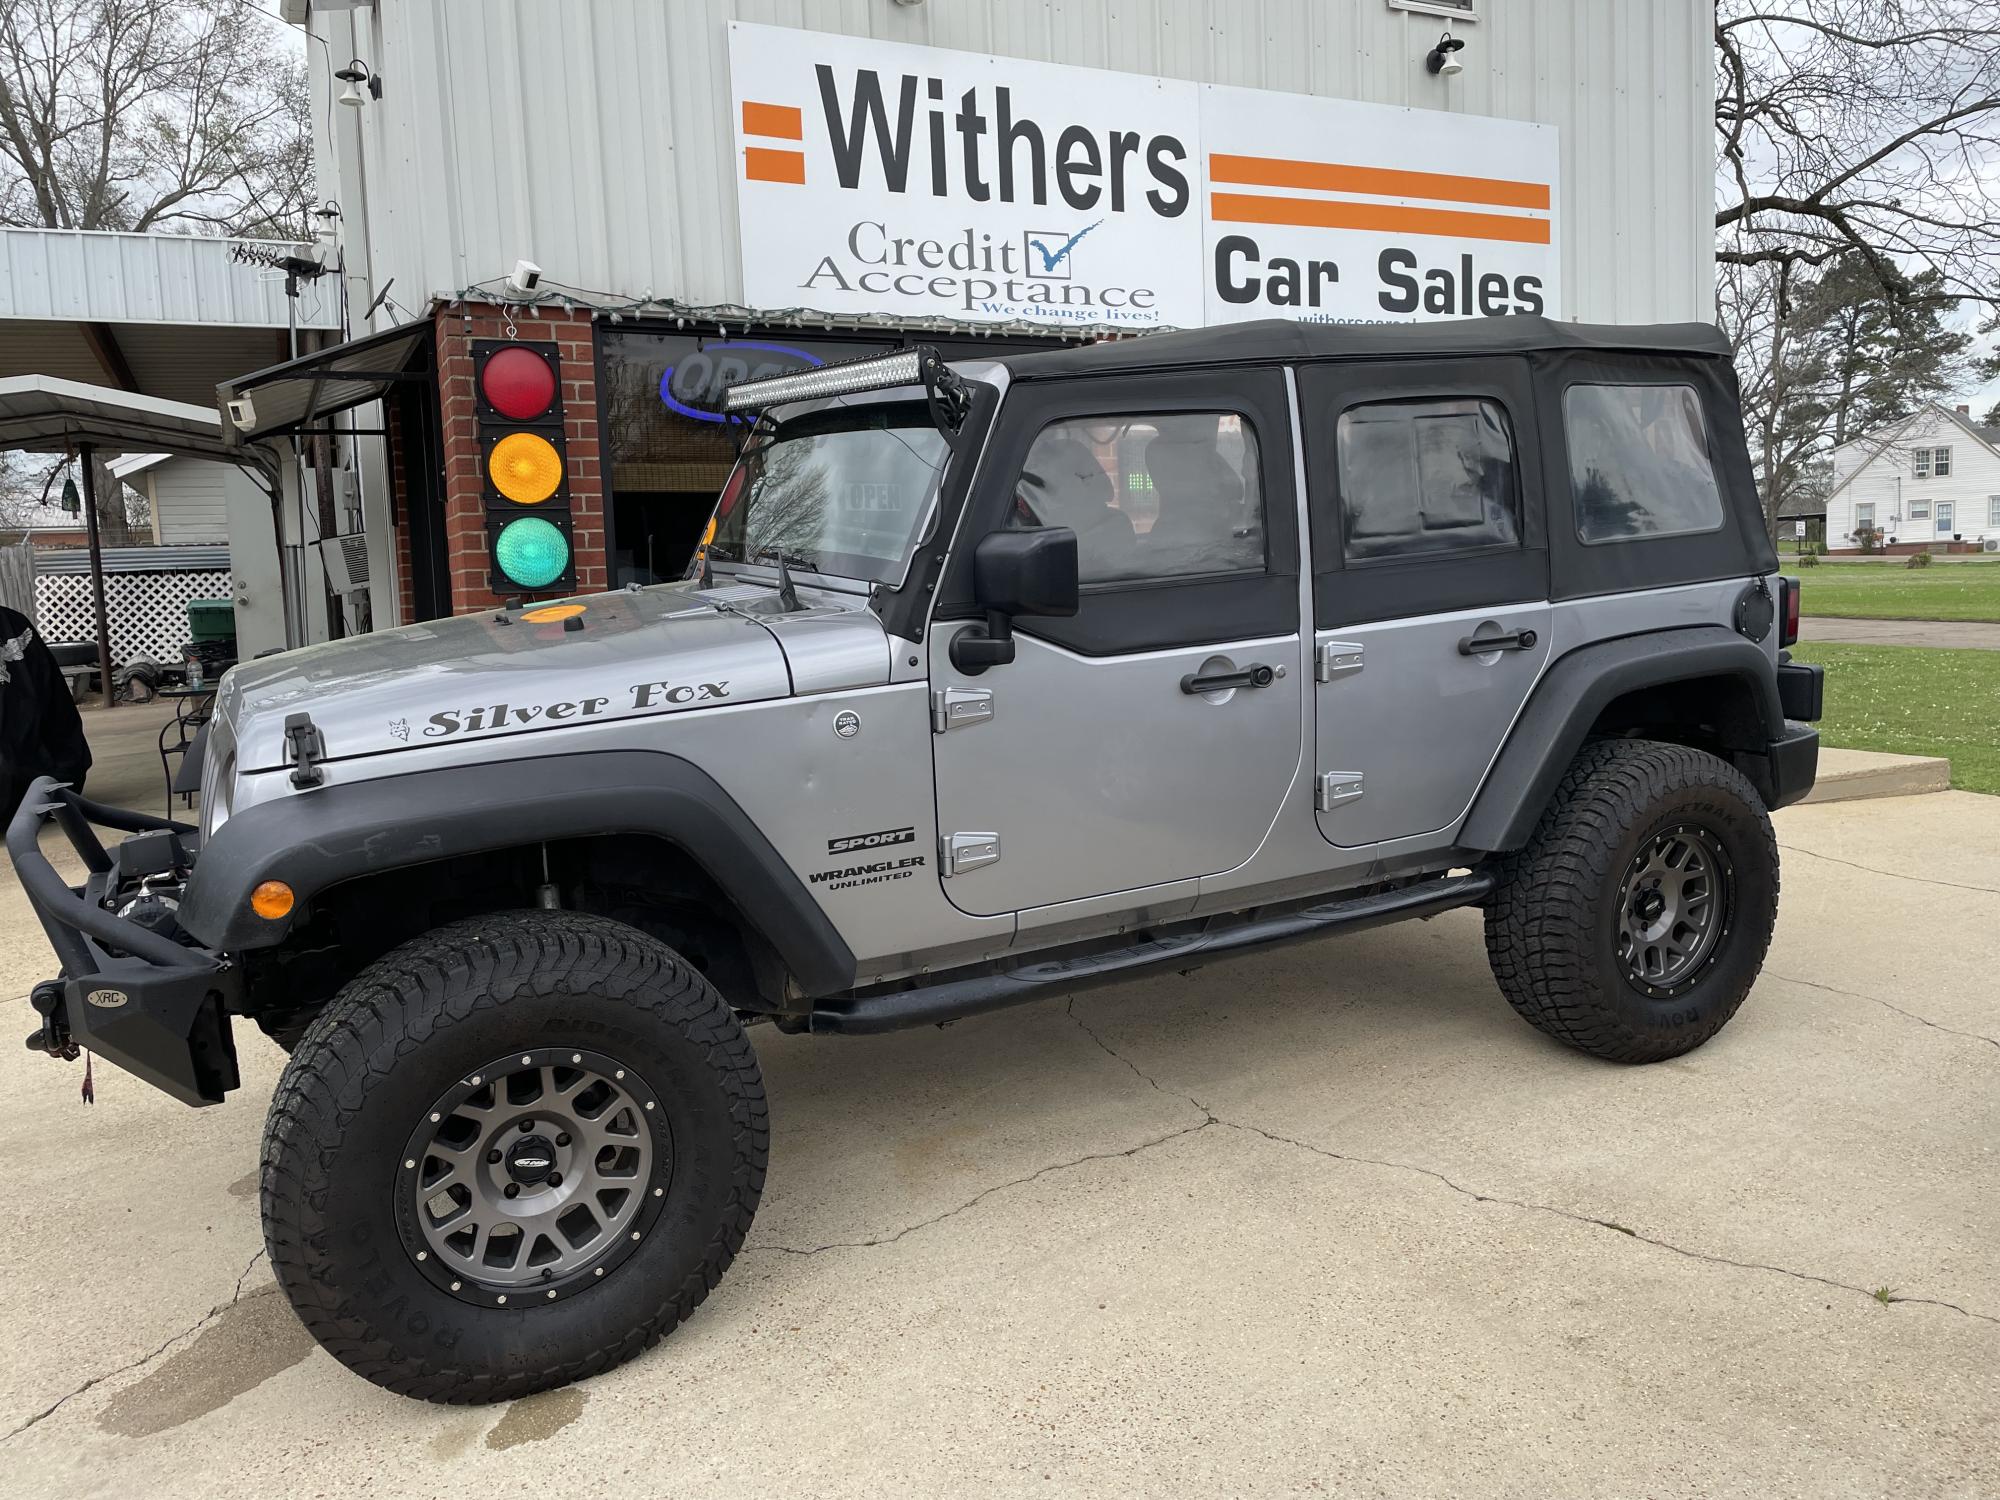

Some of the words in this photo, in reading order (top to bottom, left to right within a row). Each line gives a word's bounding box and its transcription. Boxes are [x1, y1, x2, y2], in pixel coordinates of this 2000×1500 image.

[814, 64, 1190, 218] Withers
[848, 221, 1018, 274] Credit
[797, 256, 1155, 311] Acceptance
[1214, 234, 1339, 307] Car
[1378, 247, 1544, 317] Sales
[982, 302, 1015, 314] We
[1022, 305, 1098, 321] change
[1106, 308, 1159, 321] lives!
[423, 697, 609, 737] Silver
[629, 680, 730, 710] Fox
[829, 829, 914, 853] SPORT
[809, 856, 926, 883] WRANGLER
[829, 871, 913, 890] UNLIMITED
[95, 992, 120, 1004] XRC
